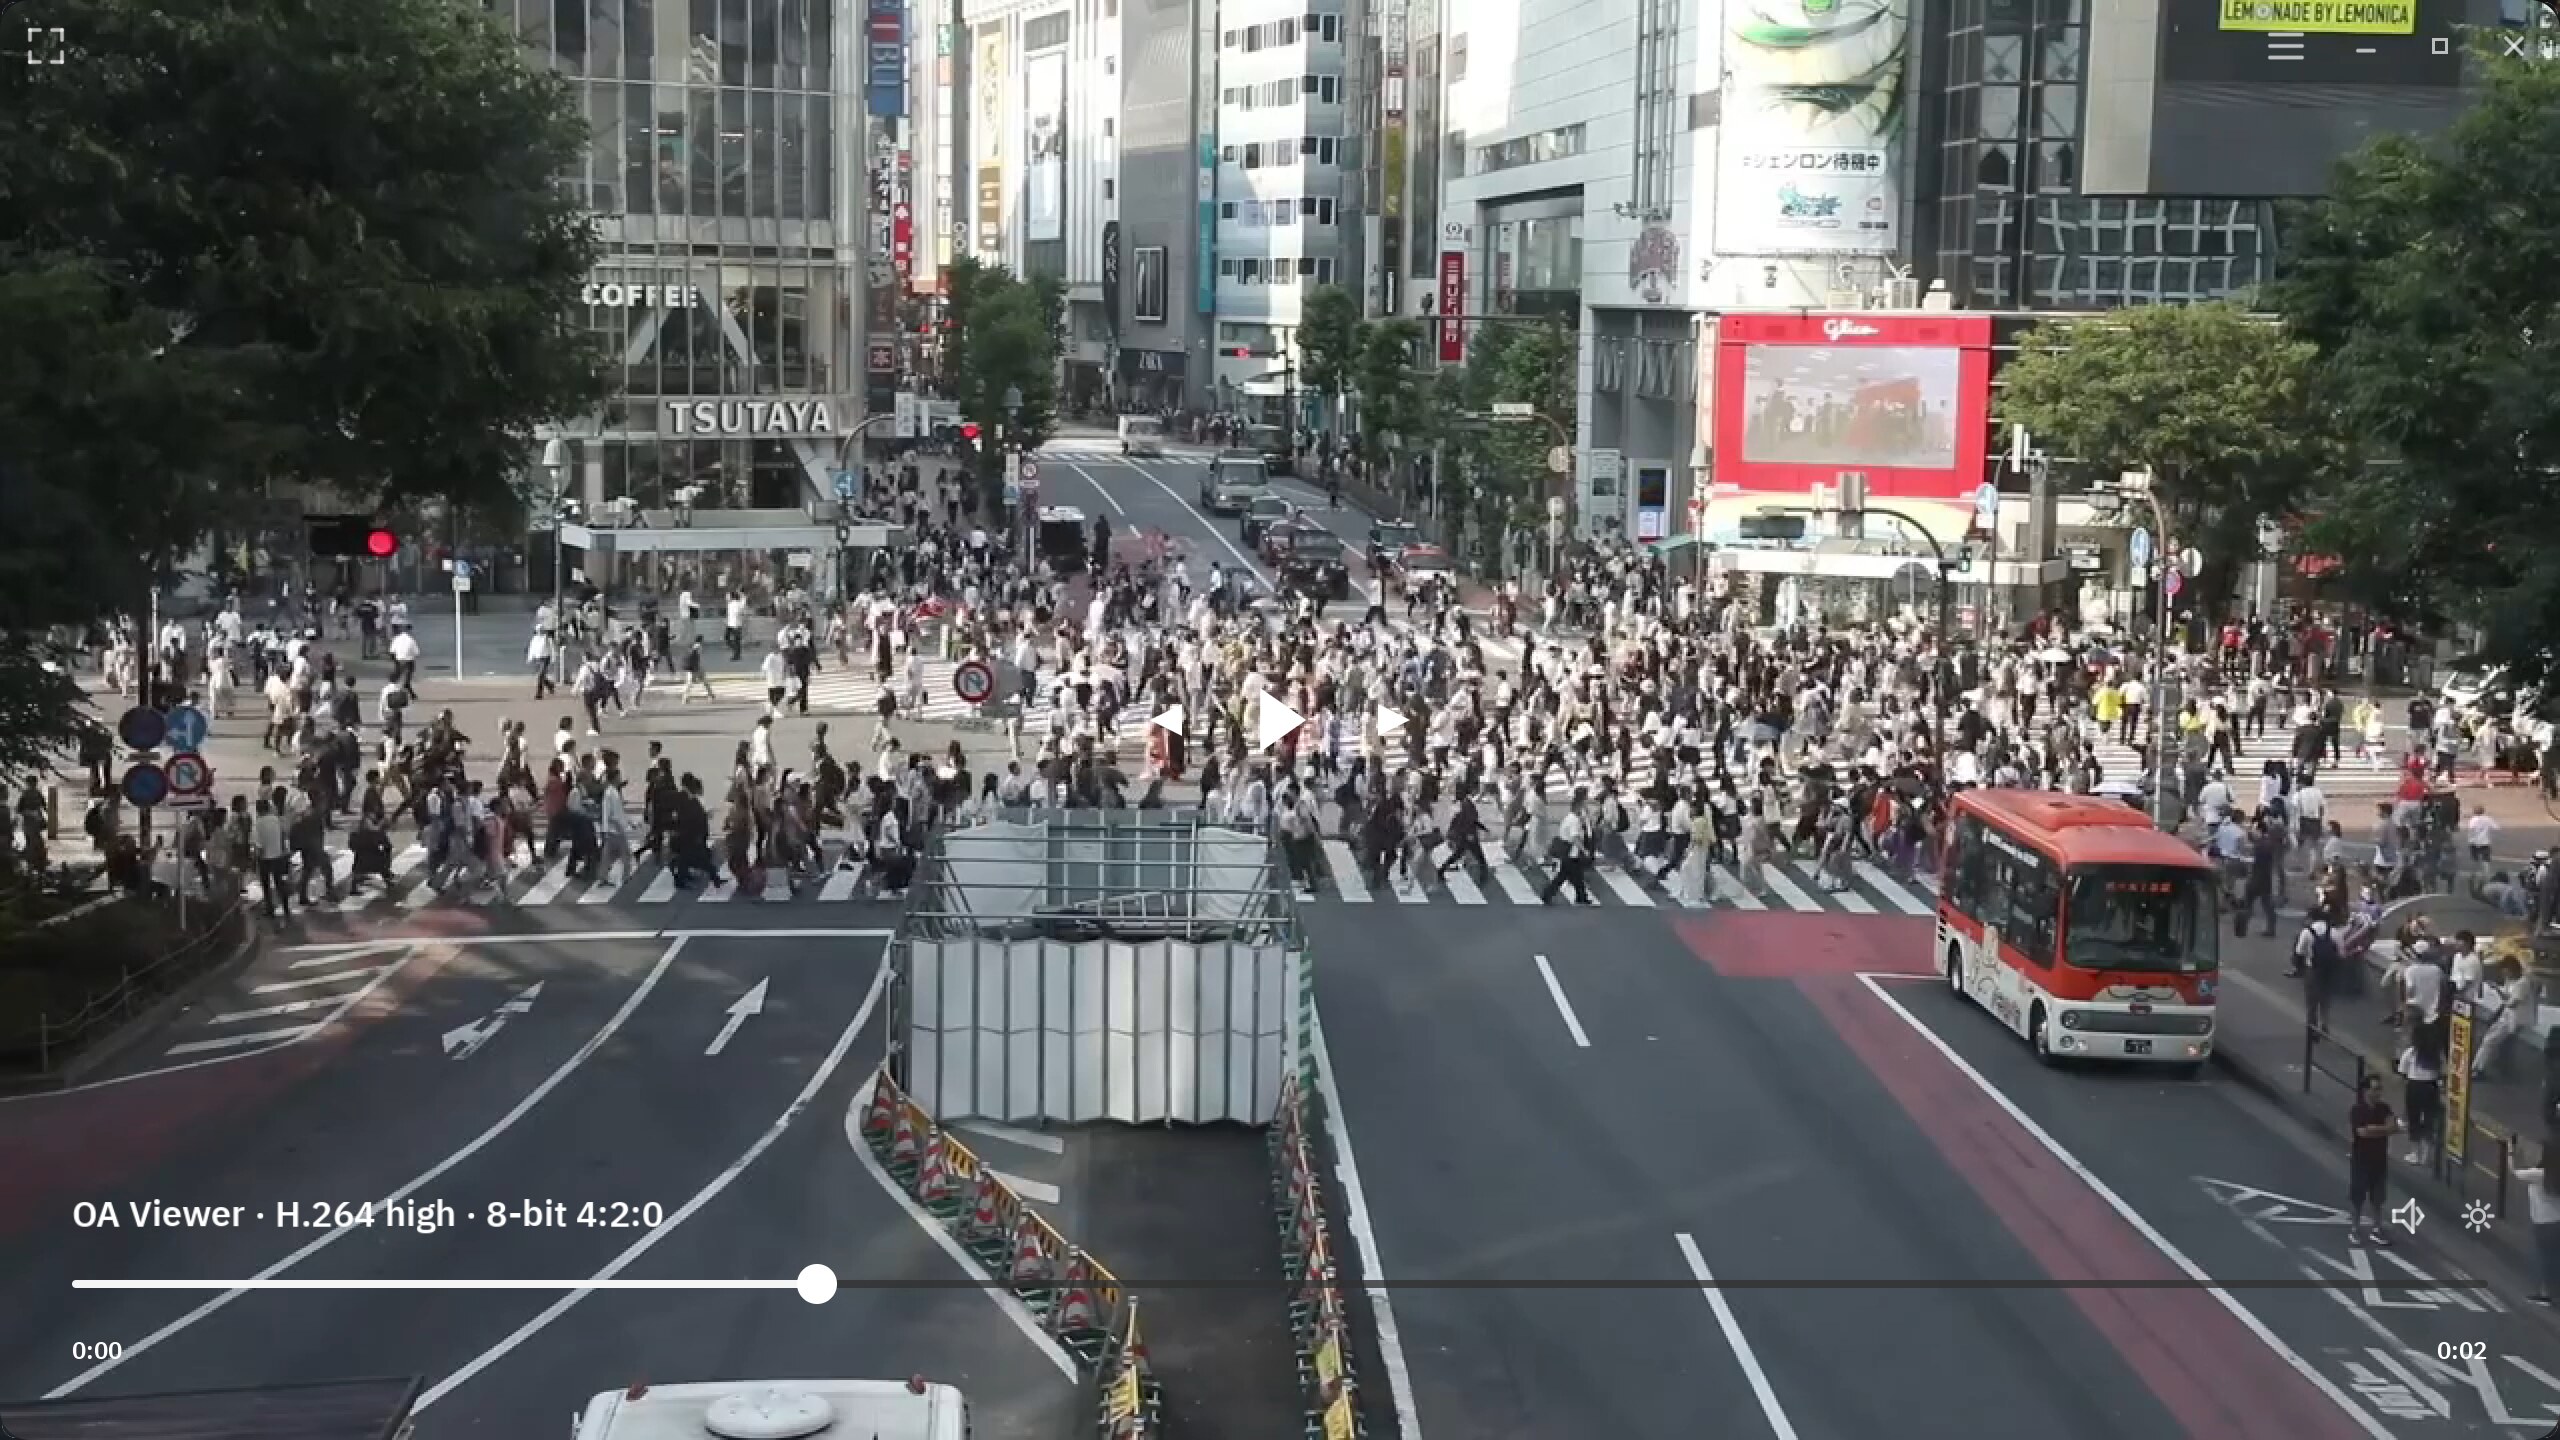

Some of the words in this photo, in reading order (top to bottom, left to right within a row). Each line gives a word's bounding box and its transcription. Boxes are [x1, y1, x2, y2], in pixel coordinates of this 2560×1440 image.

[2314, 2, 2334, 23] BY
[2336, 3, 2409, 24] LEMONICA
[582, 283, 699, 308] COFFEE
[1823, 320, 1880, 341] Glico
[667, 401, 832, 433] TSUTAYA
